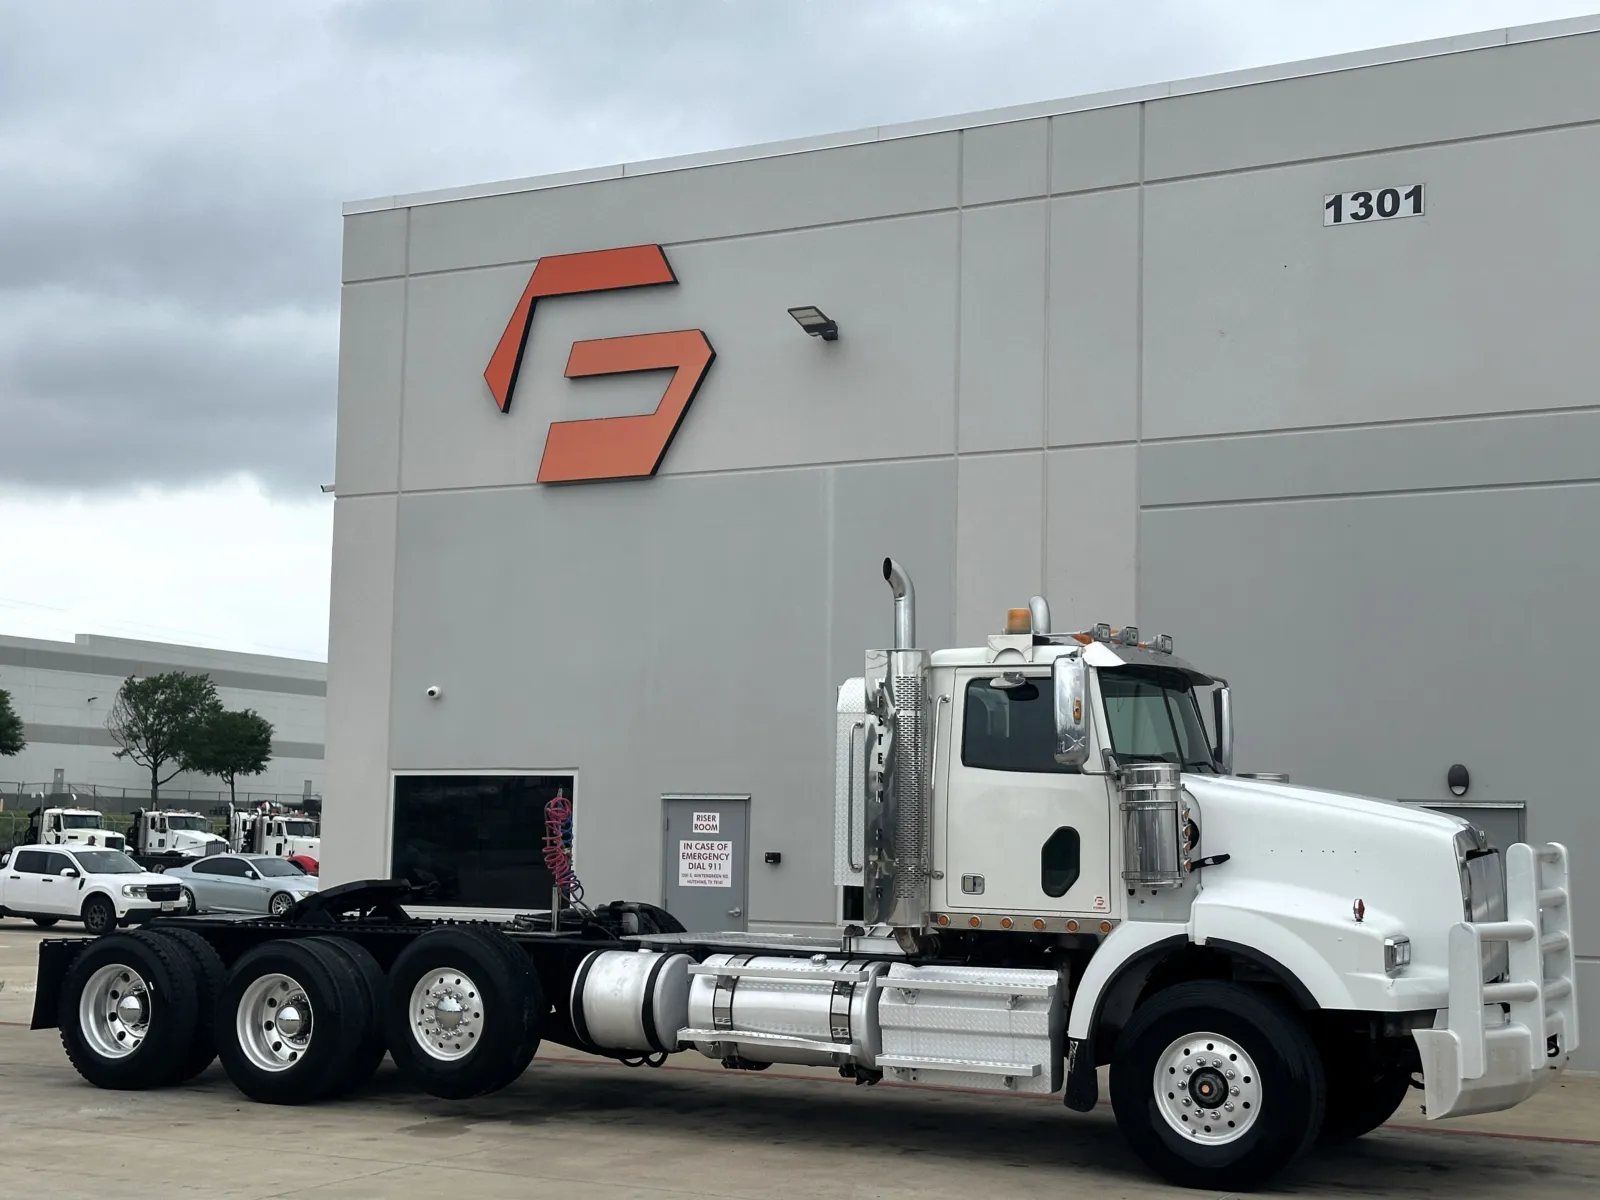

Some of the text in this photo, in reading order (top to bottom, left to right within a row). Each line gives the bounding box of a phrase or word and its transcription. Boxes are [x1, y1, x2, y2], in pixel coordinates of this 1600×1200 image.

[1325, 184, 1422, 223] 1301
[696, 814, 716, 822] RISER
[694, 823, 718, 831] ROOM
[683, 842, 728, 851] IN CASE OF
[681, 852, 729, 861] EMERGENCY
[688, 862, 722, 871] DIAL 911
